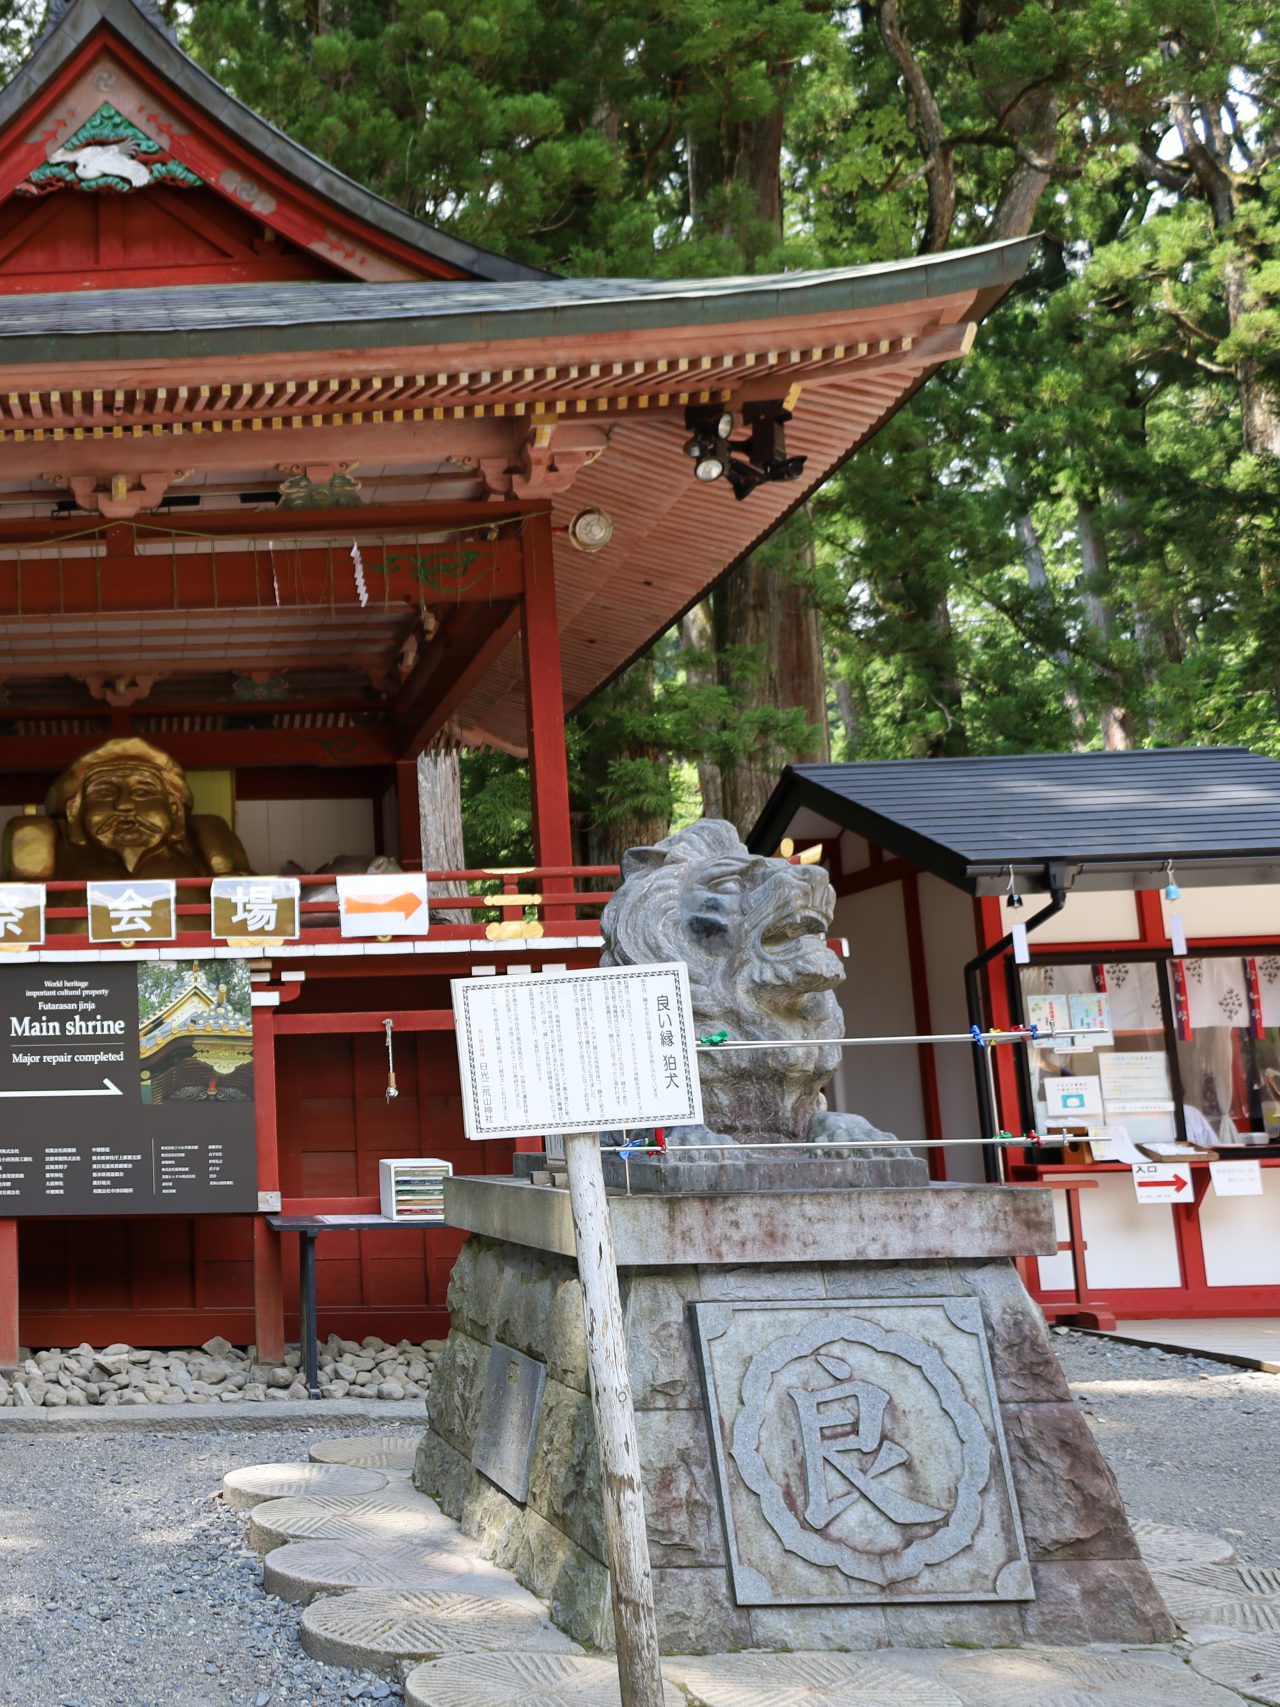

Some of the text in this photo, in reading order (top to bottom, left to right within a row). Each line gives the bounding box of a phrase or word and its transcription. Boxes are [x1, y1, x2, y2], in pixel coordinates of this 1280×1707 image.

[43, 980, 89, 988] World heritage
[25, 988, 109, 998] important cultural property
[38, 1001, 96, 1012] Futarasan jinja
[9, 1014, 125, 1037] Main shrine
[656, 994, 680, 1089] 良い縁 狛犬
[12, 1051, 125, 1066] Major repair completed
[1135, 1165, 1157, 1174] 入口
[788, 1353, 949, 1530] 良
